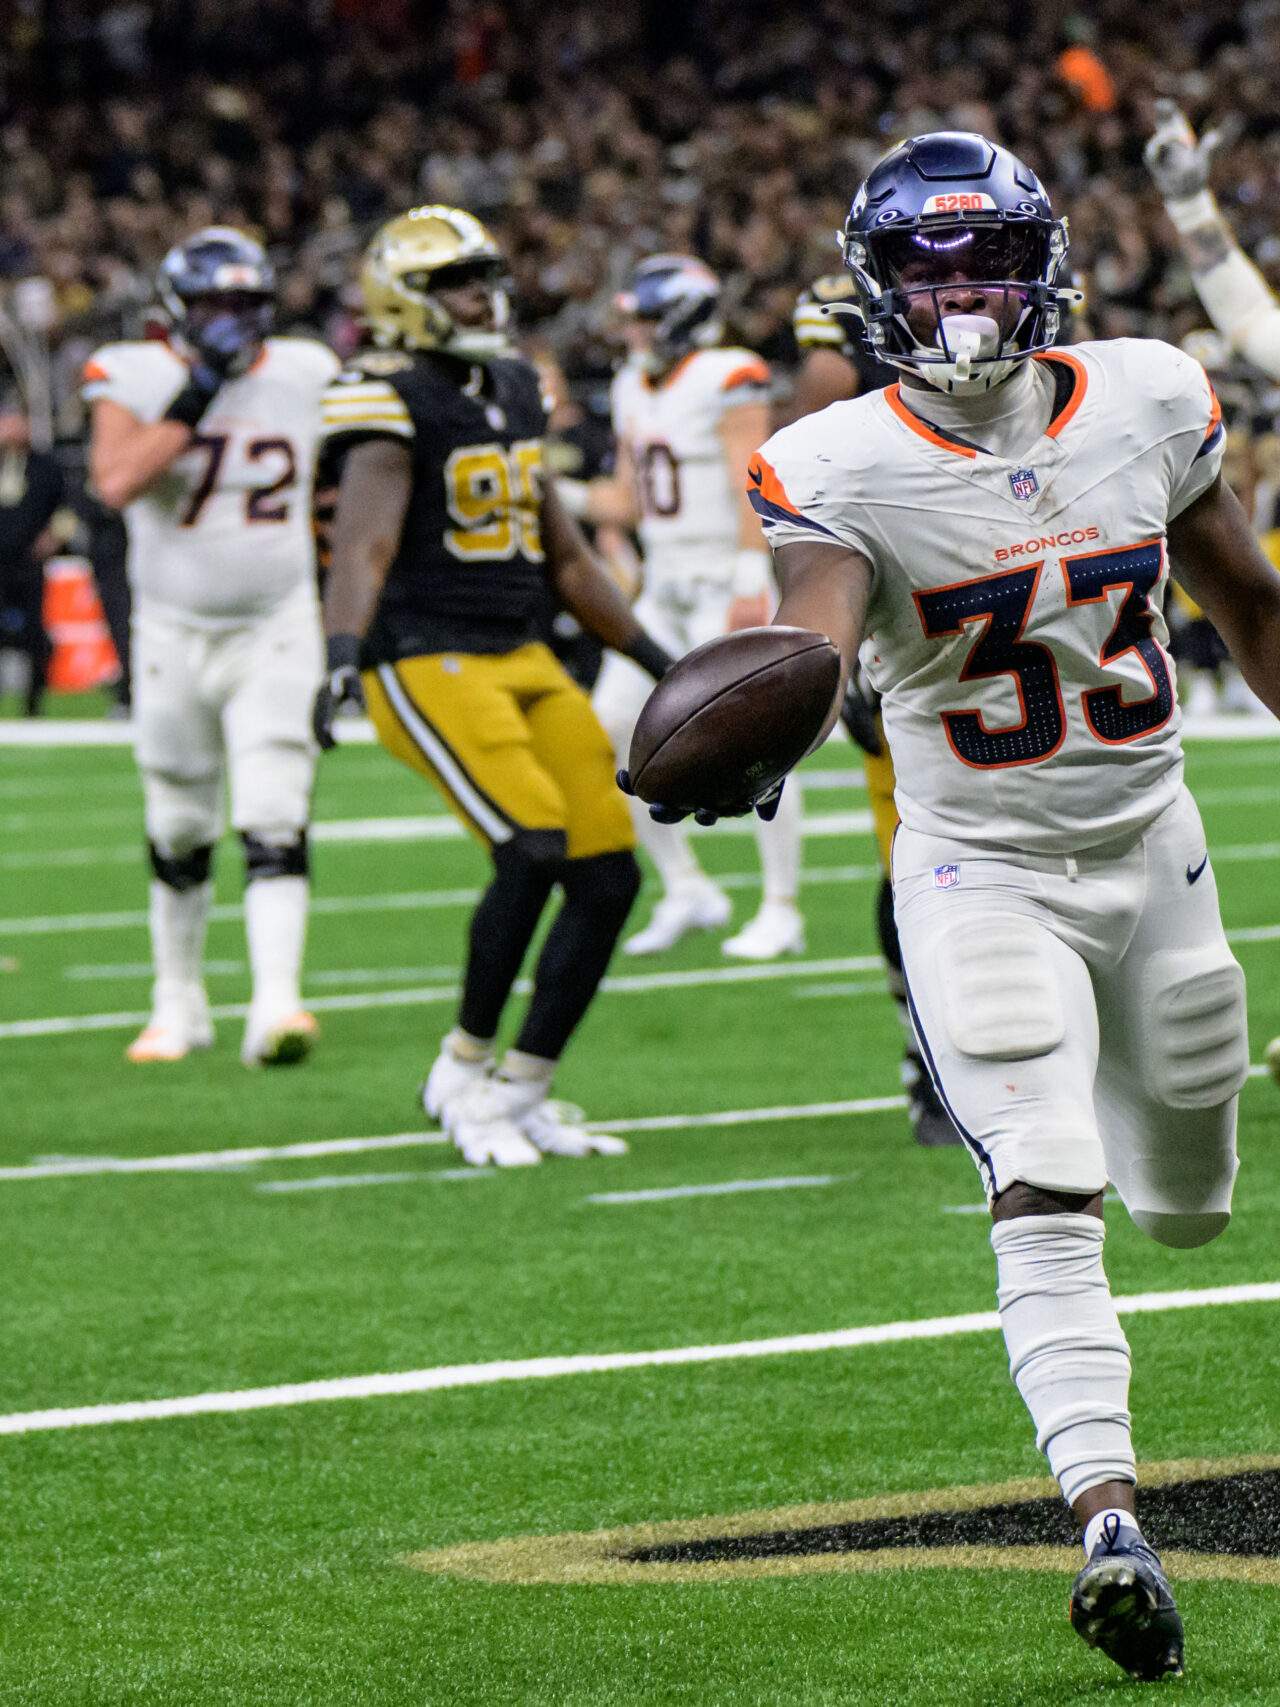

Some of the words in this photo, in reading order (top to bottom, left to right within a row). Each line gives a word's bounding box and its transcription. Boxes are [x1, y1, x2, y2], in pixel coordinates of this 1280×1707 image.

[934, 194, 983, 212] 5280
[180, 435, 296, 528] 72
[1015, 480, 1036, 496] NFL
[994, 526, 1100, 561] BRONCOS
[911, 538, 1174, 771] 33
[937, 871, 955, 886] NFL
